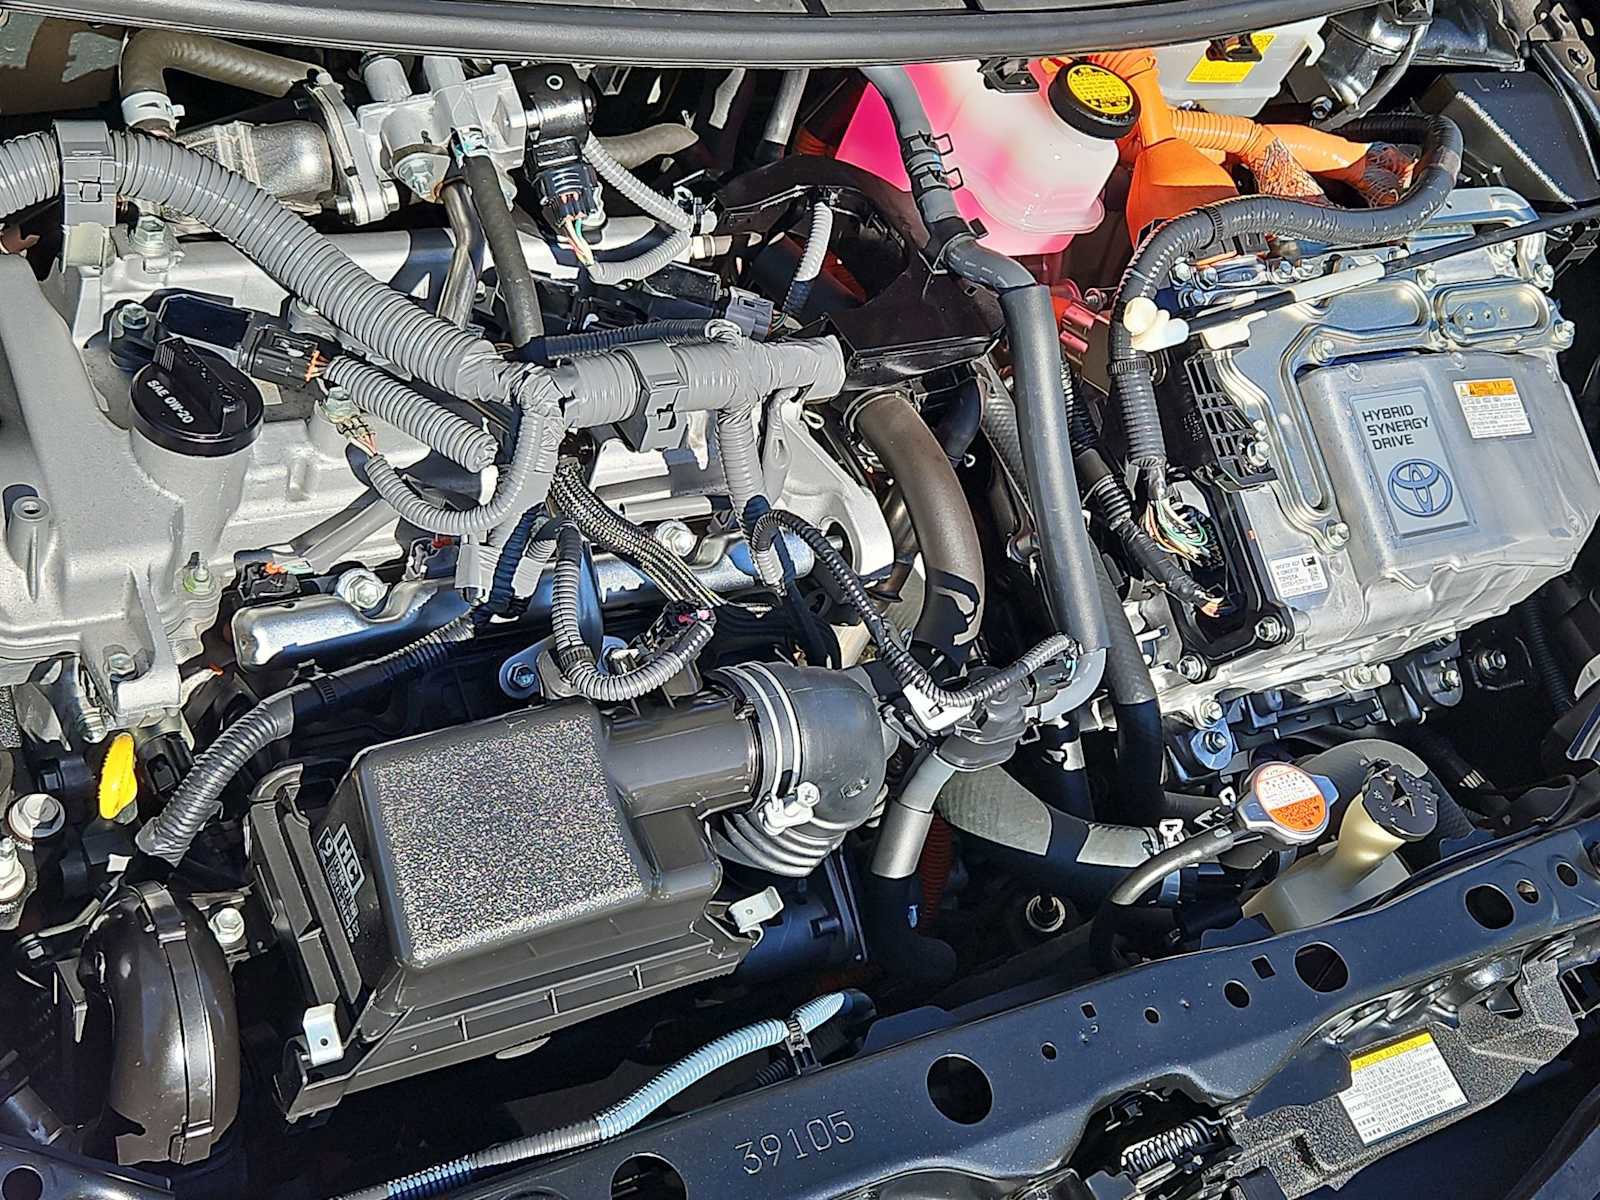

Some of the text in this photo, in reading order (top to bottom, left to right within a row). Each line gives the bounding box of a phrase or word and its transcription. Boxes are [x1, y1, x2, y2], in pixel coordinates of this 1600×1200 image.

[147, 380, 195, 423] SAE 0W-20
[1362, 404, 1414, 422] HYBRID
[1367, 417, 1429, 436] SYNERGY
[1372, 434, 1415, 451] DRIVE
[339, 838, 358, 881] HC
[735, 1110, 855, 1174] 39105
